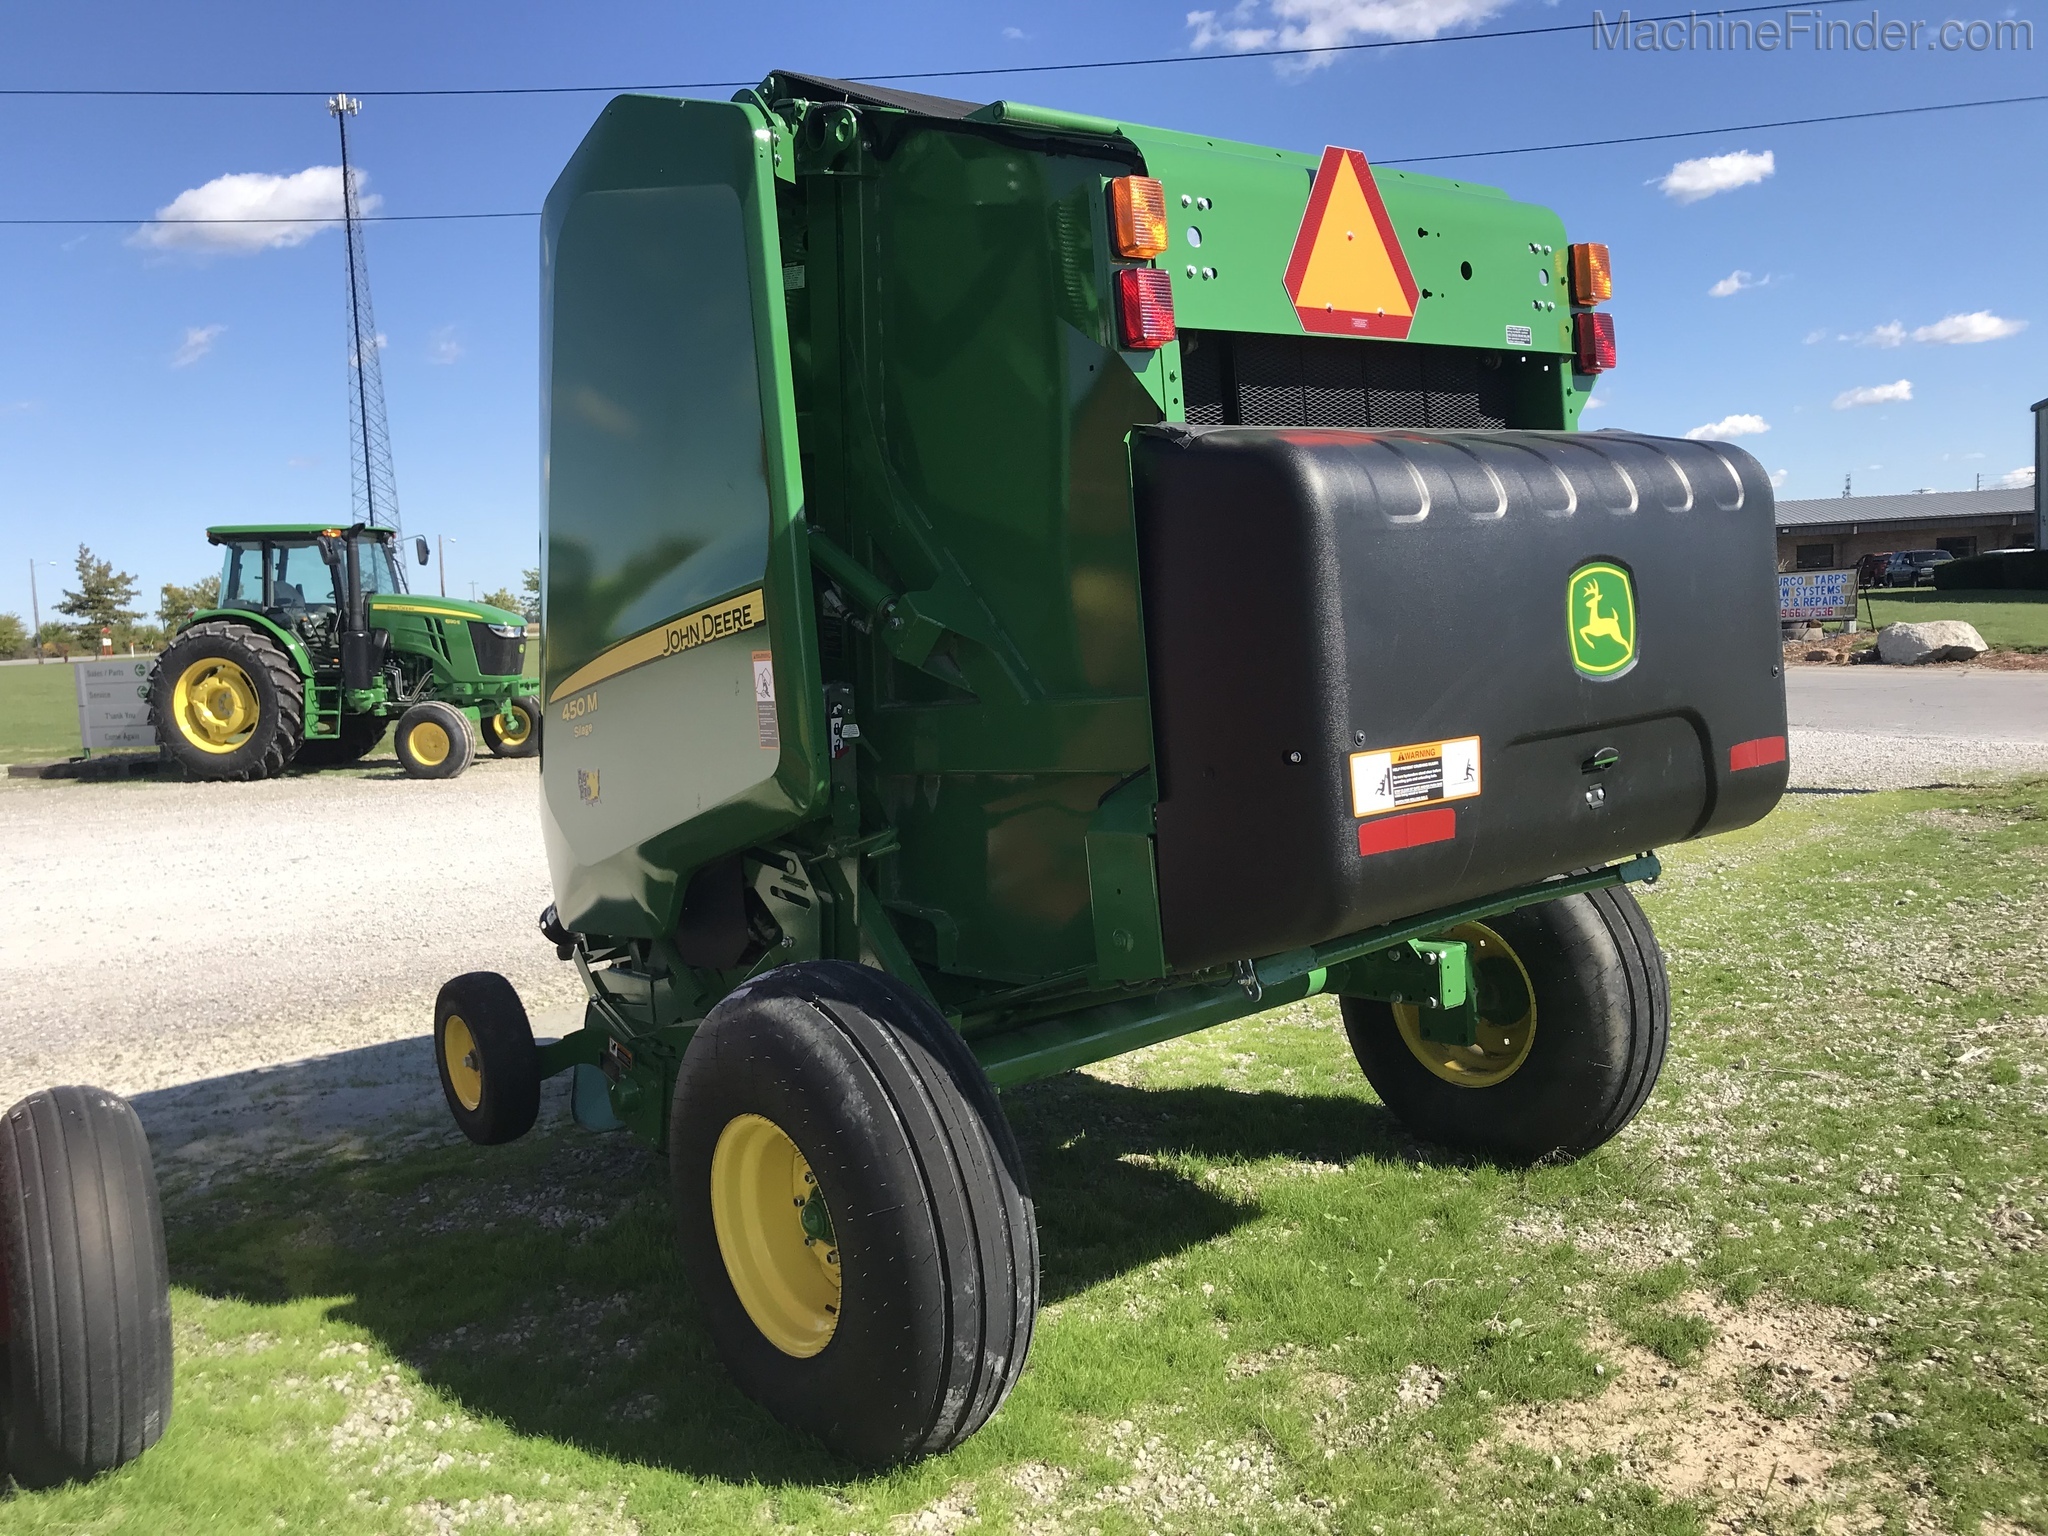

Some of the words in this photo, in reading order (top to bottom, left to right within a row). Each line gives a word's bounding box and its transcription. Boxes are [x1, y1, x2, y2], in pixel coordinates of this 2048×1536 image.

[1815, 574, 1847, 585] TARPS
[1780, 587, 1790, 597] W
[1796, 585, 1840, 596] SYSTEMS
[1793, 598, 1800, 607] &
[1803, 596, 1844, 606] REPAIRS
[1809, 607, 1833, 617] 7536
[662, 623, 700, 654] JOHN
[702, 604, 752, 638] DEERE
[562, 697, 585, 720] 450
[587, 691, 598, 713] M
[574, 723, 593, 738] Silage
[1404, 748, 1435, 760] WARNING
